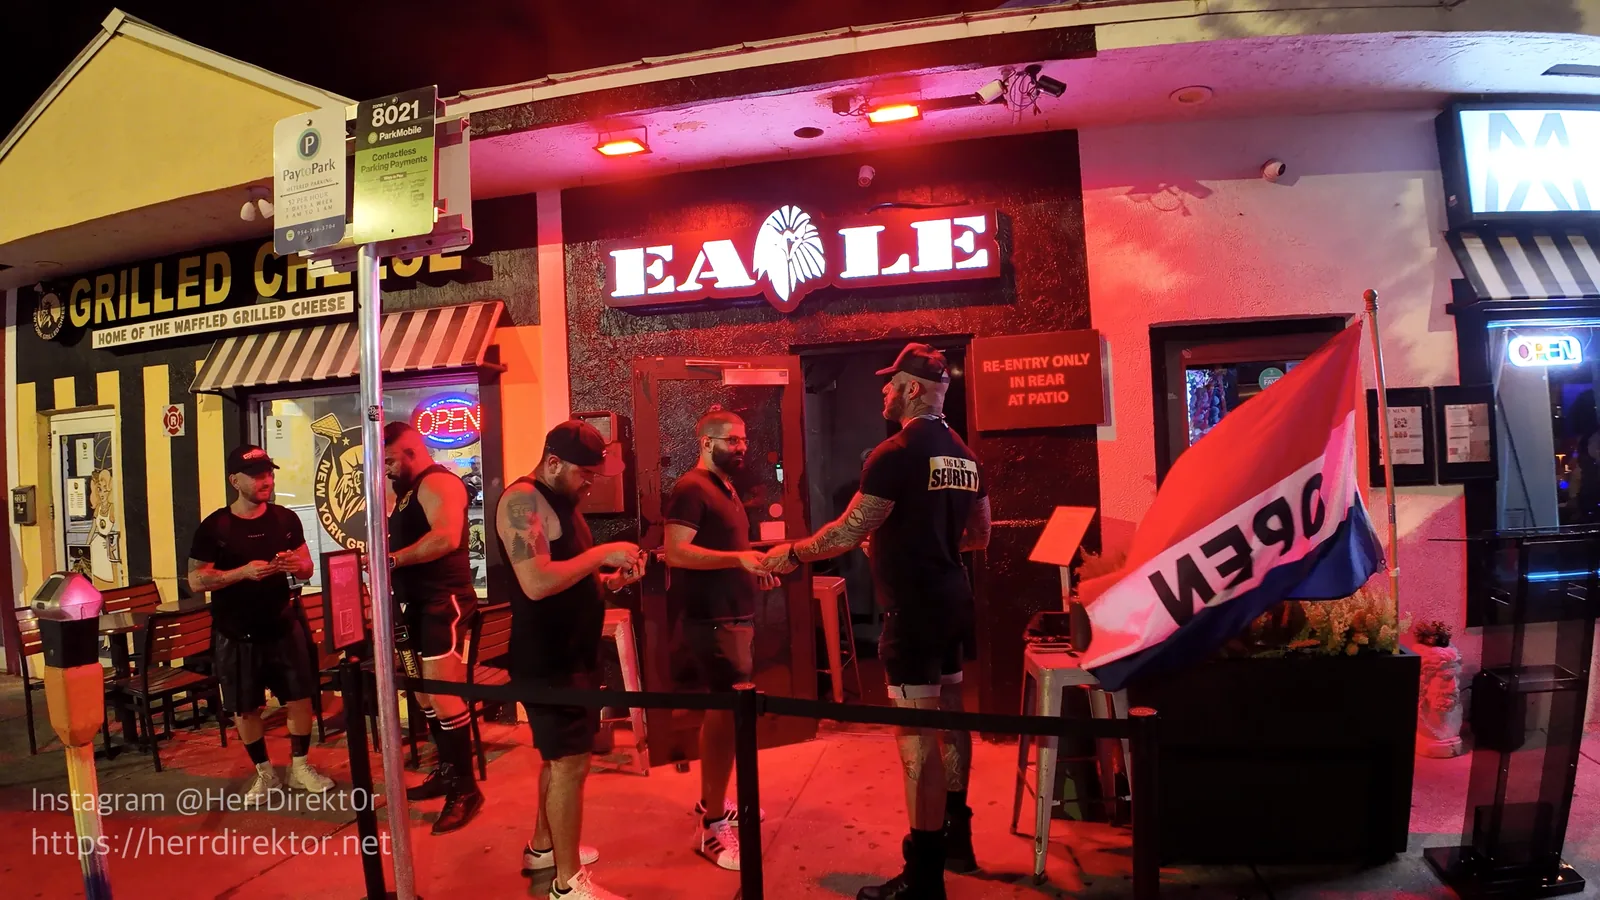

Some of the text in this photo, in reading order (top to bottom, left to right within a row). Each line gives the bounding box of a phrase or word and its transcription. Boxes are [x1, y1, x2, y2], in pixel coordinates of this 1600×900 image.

[371, 100, 419, 127] 8021
[379, 126, 422, 141] ParkMobile
[305, 136, 314, 153] P
[372, 147, 417, 162] Contactless
[361, 154, 428, 174] Parking Payments
[310, 178, 333, 186] PARKING
[69, 251, 232, 328] GRILLED
[98, 296, 346, 345] HOME OF THE WAFFLED GRILLED CHEESE
[1513, 338, 1578, 362] OPEN
[983, 353, 1090, 372] RE-ENTRY ONLY
[1010, 373, 1065, 388] IN REAR
[1008, 391, 1069, 406] AT PATIO
[170, 416, 177, 426] R
[417, 405, 480, 435] OPEN
[316, 459, 331, 498] NEW
[931, 468, 978, 490] SEURITY
[319, 502, 346, 543] YORK
